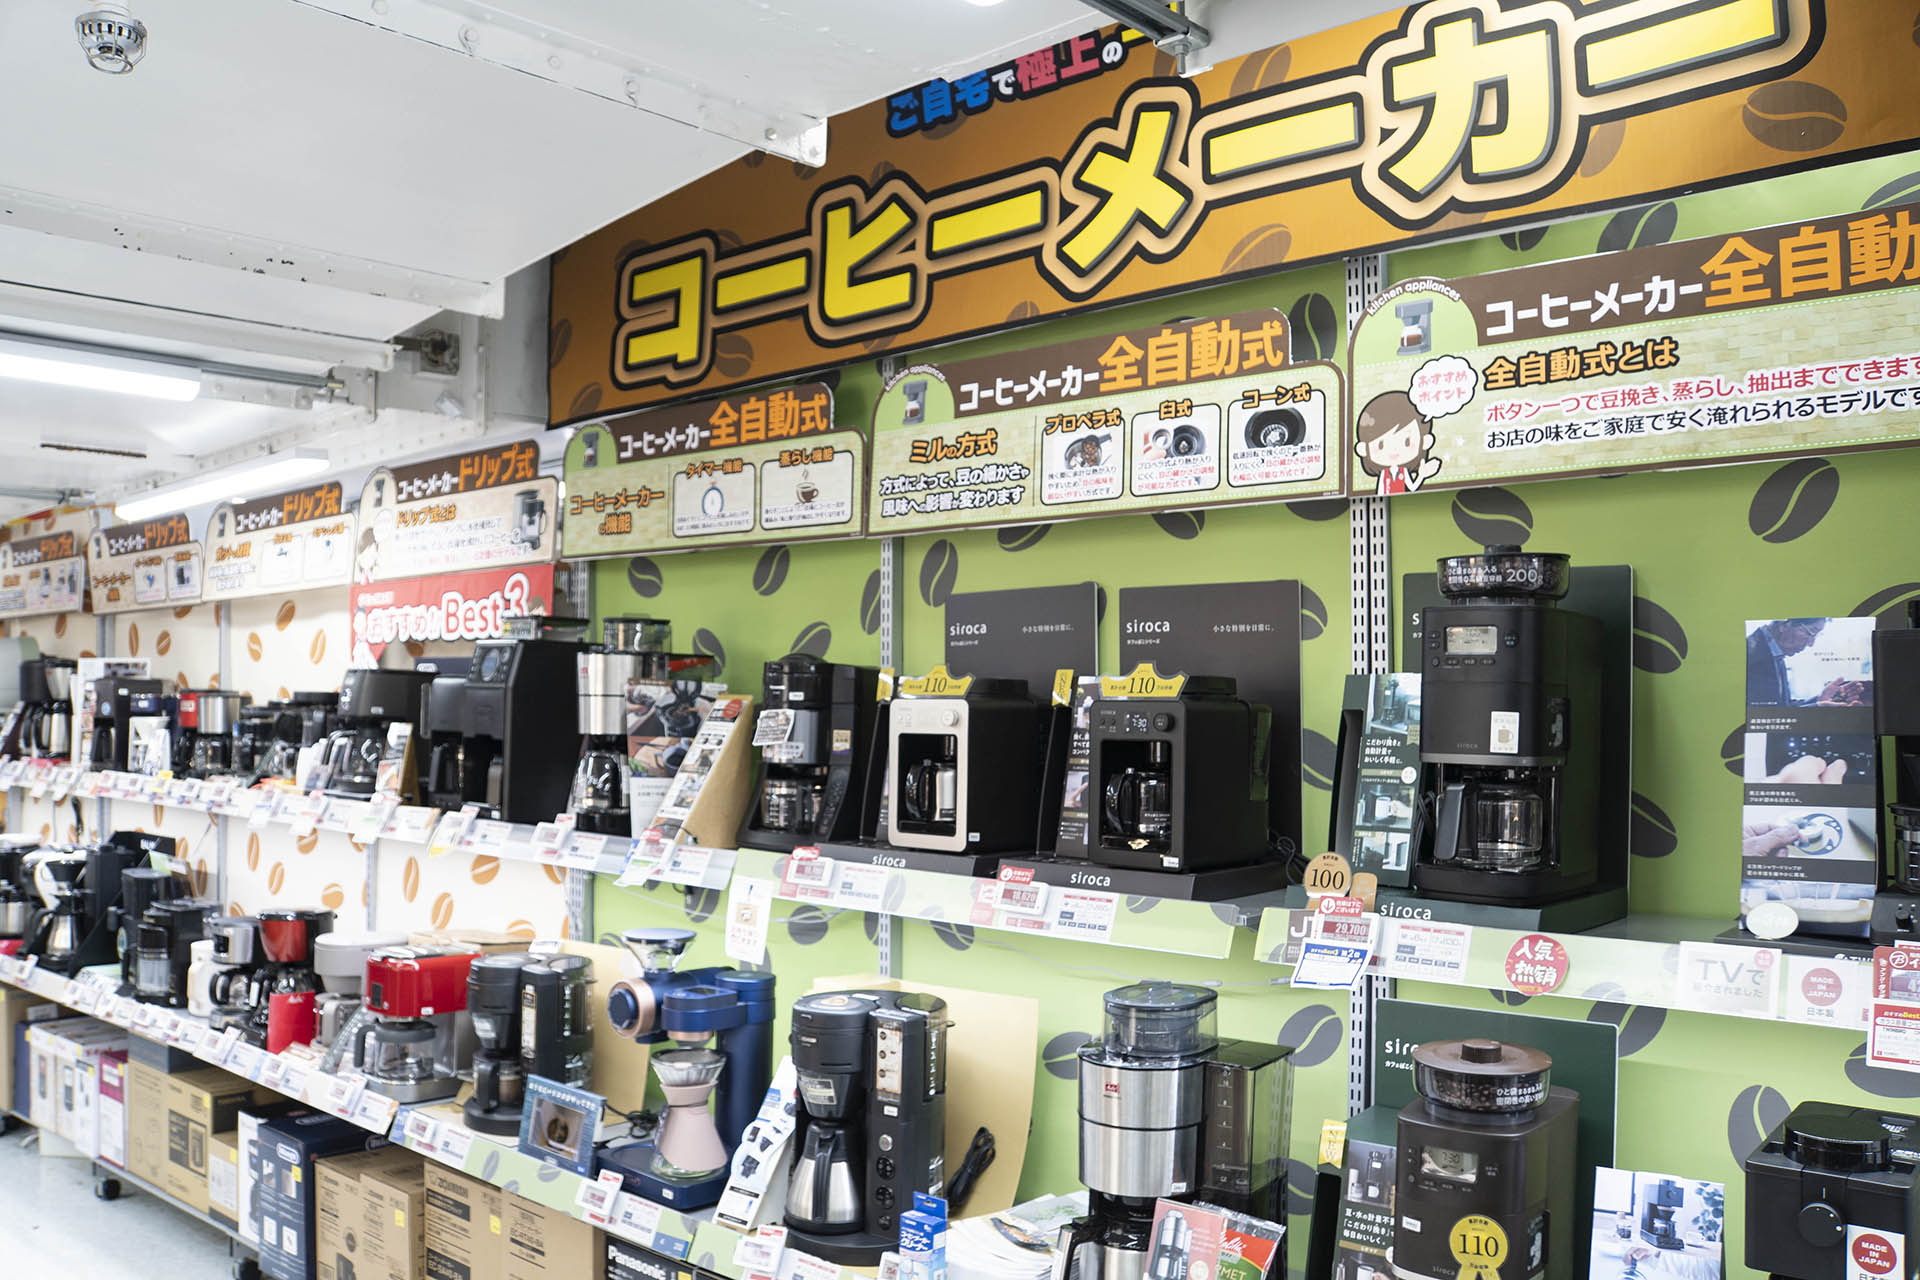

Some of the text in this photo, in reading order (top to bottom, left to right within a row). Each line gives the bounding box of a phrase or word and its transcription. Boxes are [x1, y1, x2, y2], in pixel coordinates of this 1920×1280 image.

[622, 0, 1782, 370] コーヒーメーカー
[1486, 274, 1704, 336] コーヒーメーカー
[960, 320, 1284, 411] コーヒーメーカー 全自動式
[1483, 336, 1680, 391] 全自動式とは
[1418, 370, 1468, 388] おすすめ
[1242, 382, 1312, 409] コーン式
[1418, 387, 1467, 403] ポイント
[708, 391, 828, 447] 全自動式
[1159, 398, 1192, 420] 臼式
[1045, 408, 1122, 435] プロペラ式
[910, 428, 998, 463] ミルの方式
[570, 485, 665, 515] コーヒーメーカー
[949, 622, 988, 636] siroca
[1126, 619, 1171, 633] siroca
[924, 678, 947, 692] 110
[1128, 676, 1155, 694] 110
[872, 853, 907, 868] siroca
[1070, 871, 1111, 887] siroca
[1309, 868, 1345, 890] 100
[1380, 902, 1432, 920] siroca
[1516, 938, 1555, 961] 人気
[1696, 958, 1766, 986] TVで
[1811, 976, 1834, 984] MADE
[1807, 990, 1837, 999] JAPAN
[1458, 1234, 1499, 1257] 110
[1861, 1241, 1888, 1253] MADE
[1869, 1250, 1880, 1258] IN
[608, 1244, 667, 1280] Panasonic
[1858, 1256, 1890, 1269] JAPAN
